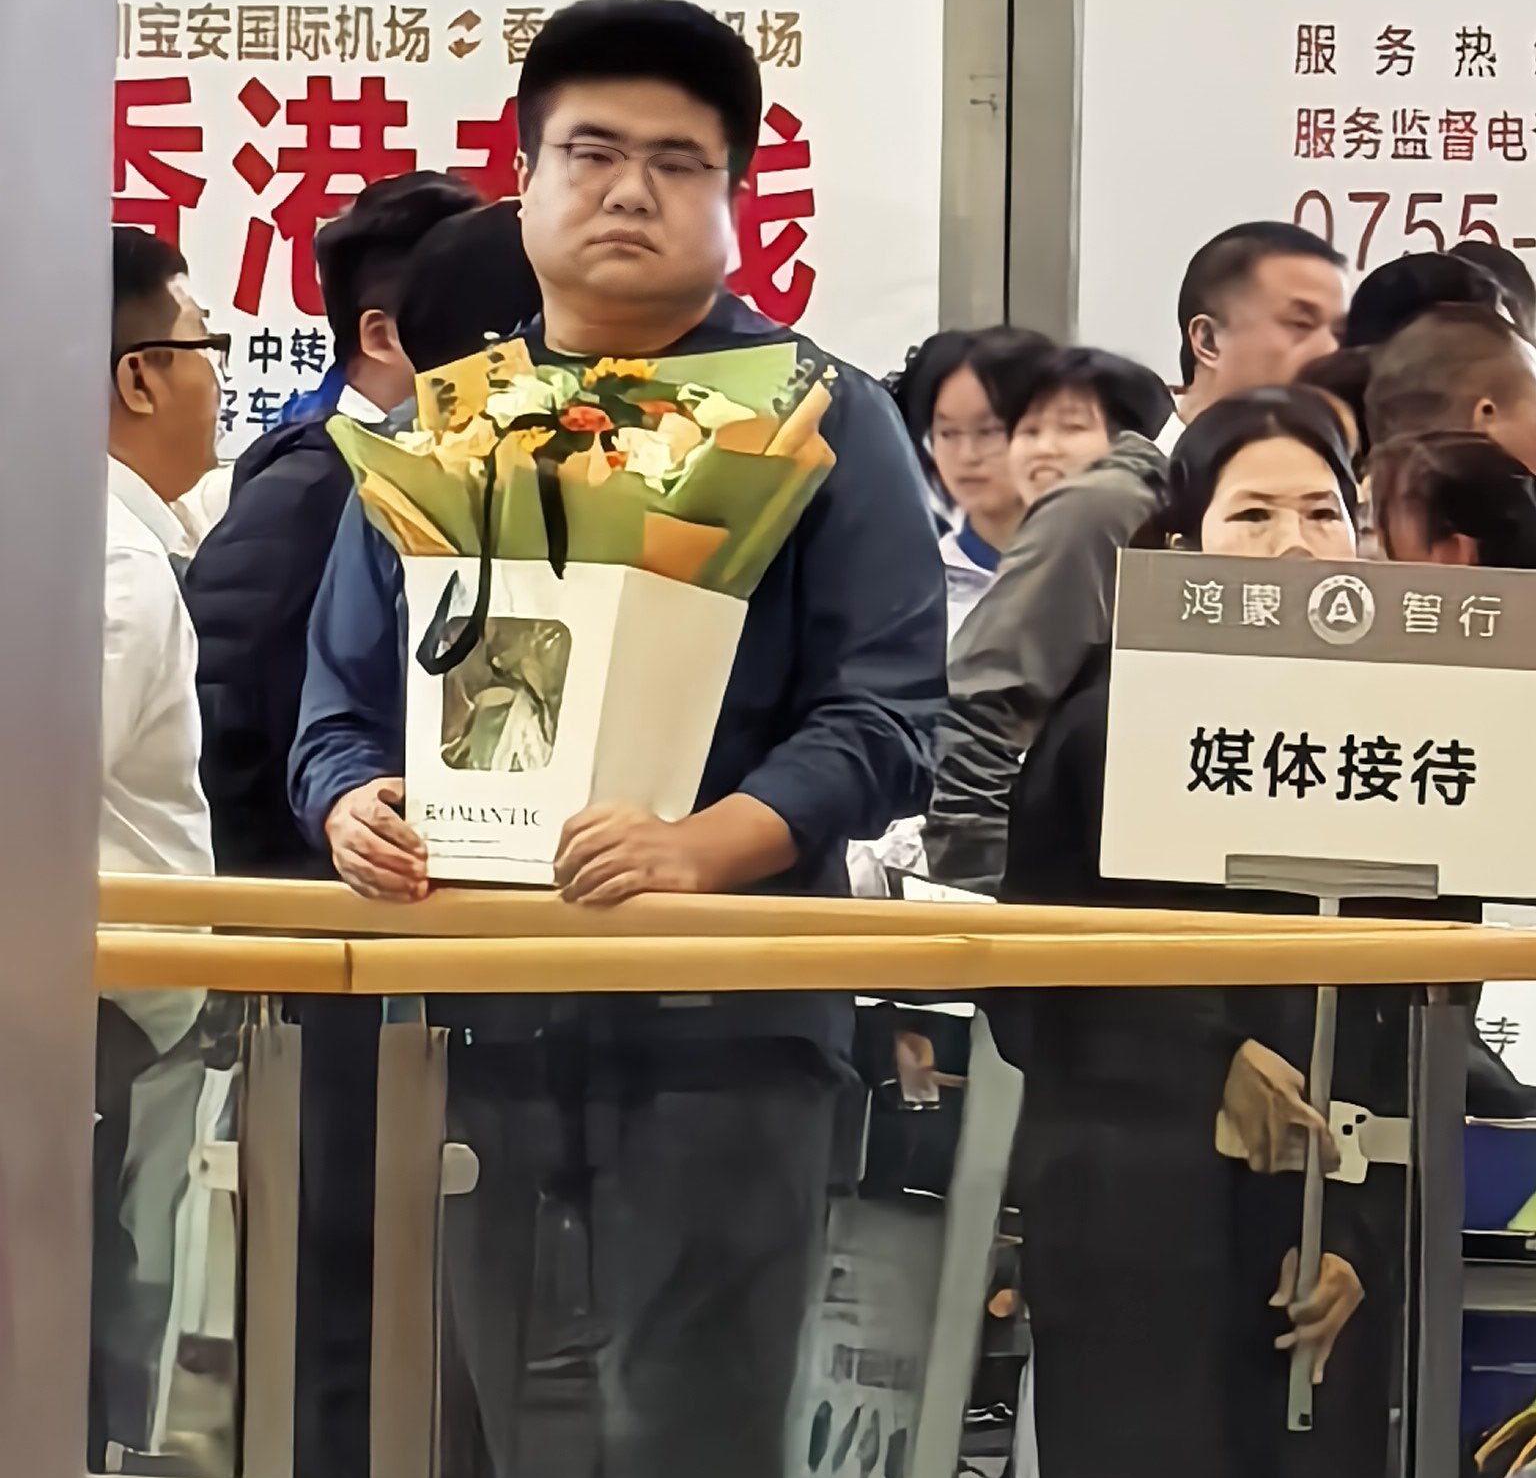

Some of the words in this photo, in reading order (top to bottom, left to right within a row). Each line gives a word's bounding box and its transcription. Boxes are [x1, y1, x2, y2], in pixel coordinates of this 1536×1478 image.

[123, 2, 430, 63] 宝安国际机场
[1181, 579, 1282, 627] 鸿蒙
[1402, 591, 1502, 637] 智行
[1187, 726, 1477, 806] 媒体接待
